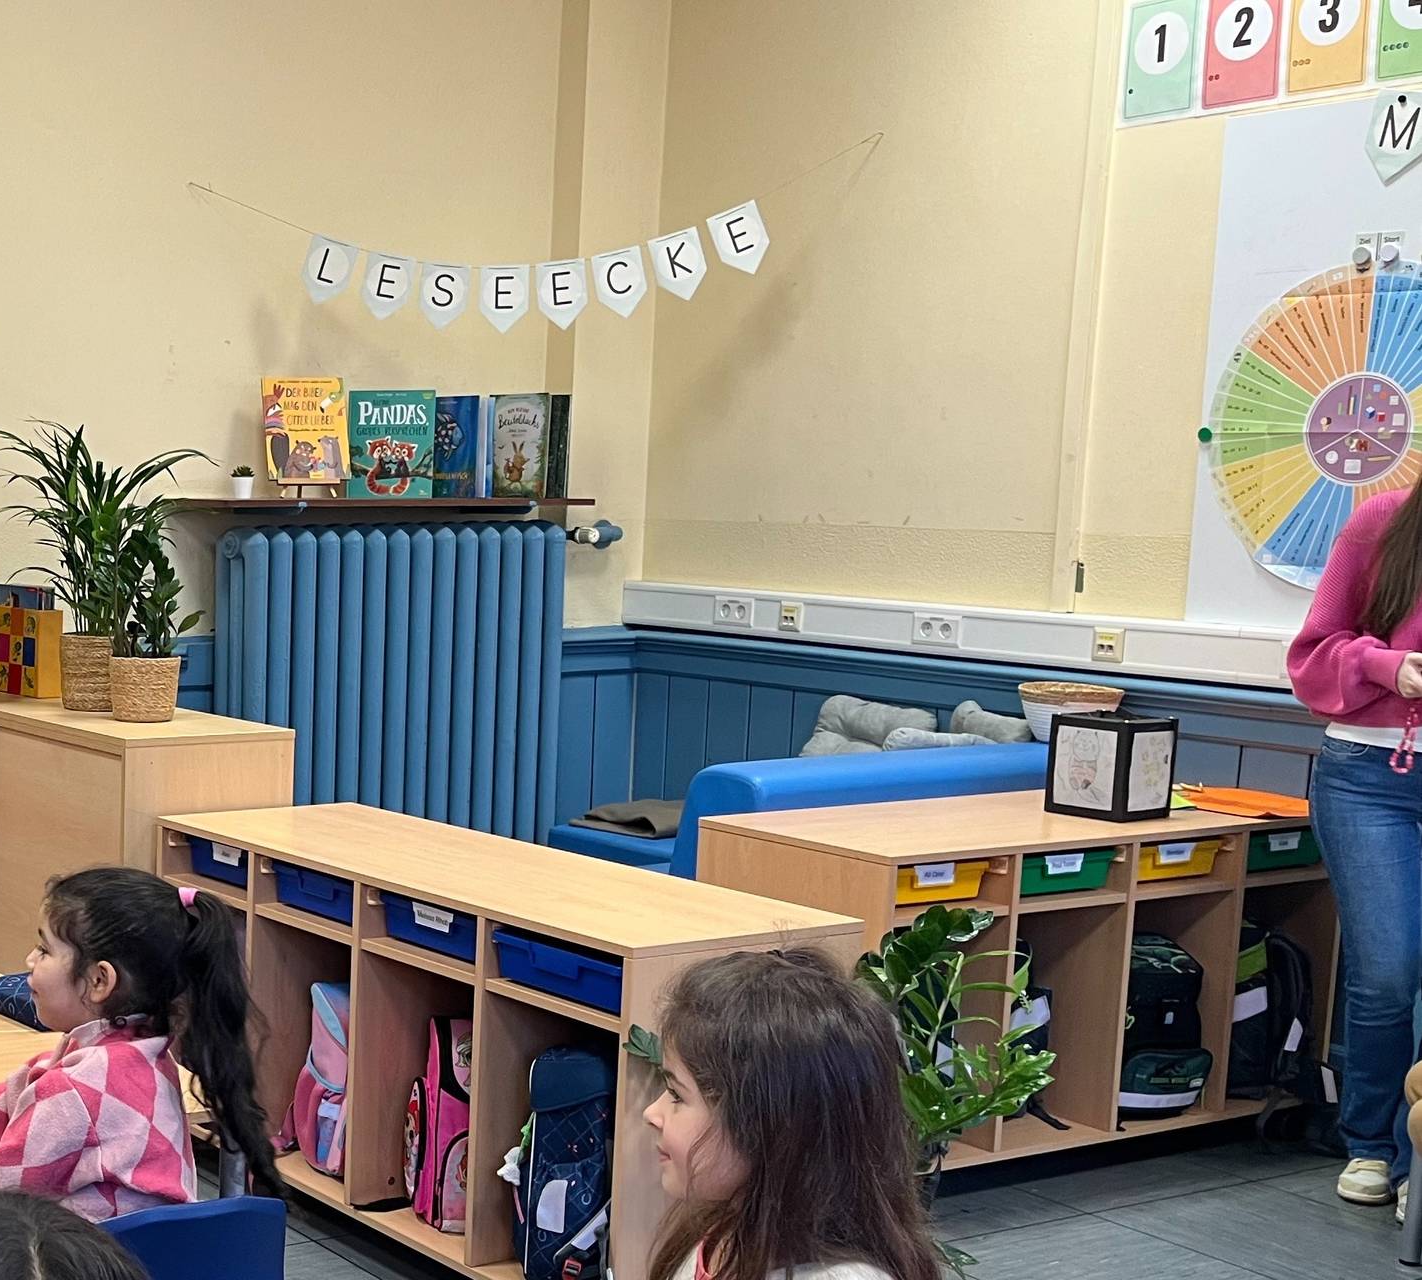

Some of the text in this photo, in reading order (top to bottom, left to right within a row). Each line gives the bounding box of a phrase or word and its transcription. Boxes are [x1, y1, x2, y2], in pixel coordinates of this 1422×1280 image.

[1232, 7, 1254, 48] 2
[1318, 0, 1340, 33] 3
[1154, 24, 1167, 63] 1
[1379, 104, 1420, 150] M
